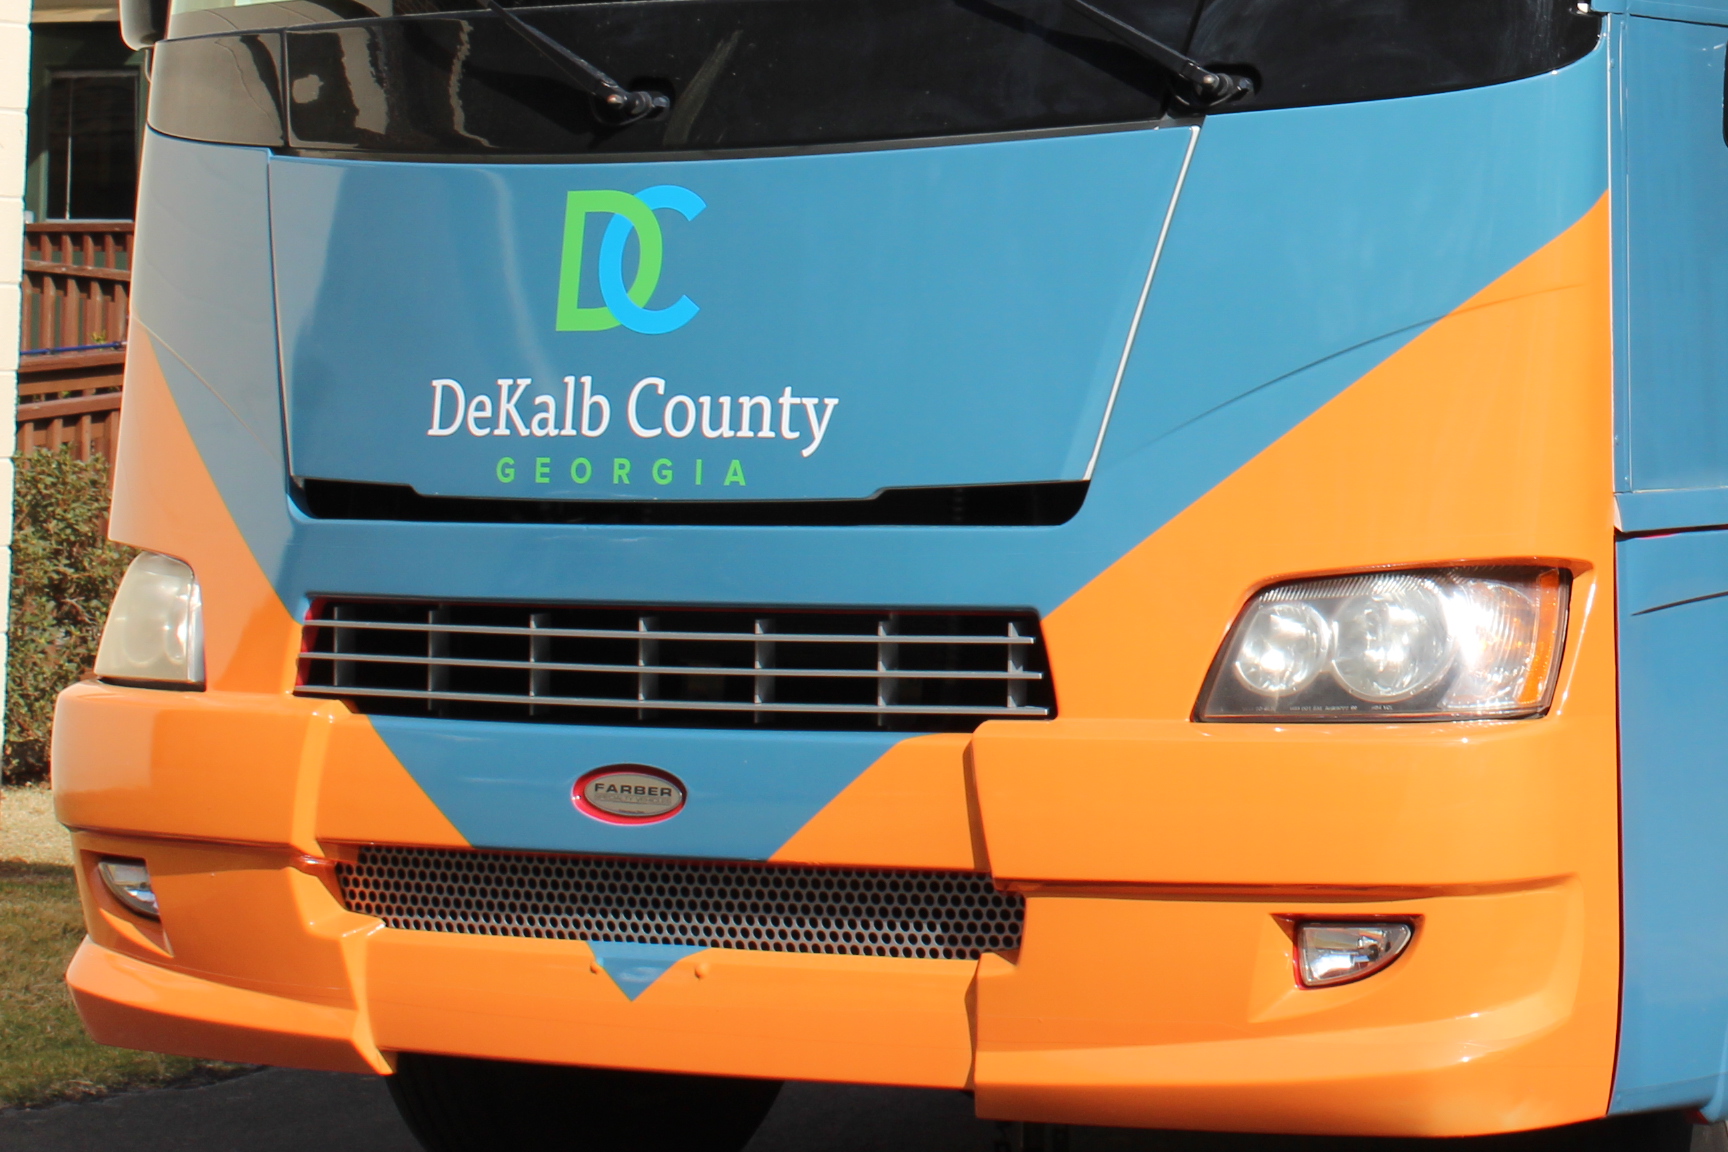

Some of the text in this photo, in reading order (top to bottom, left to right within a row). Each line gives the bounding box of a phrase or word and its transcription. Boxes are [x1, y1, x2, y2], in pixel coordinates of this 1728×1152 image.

[427, 375, 839, 458] DeKalb County
[496, 456, 747, 486] GEORGIA
[594, 783, 672, 797] FARBER
